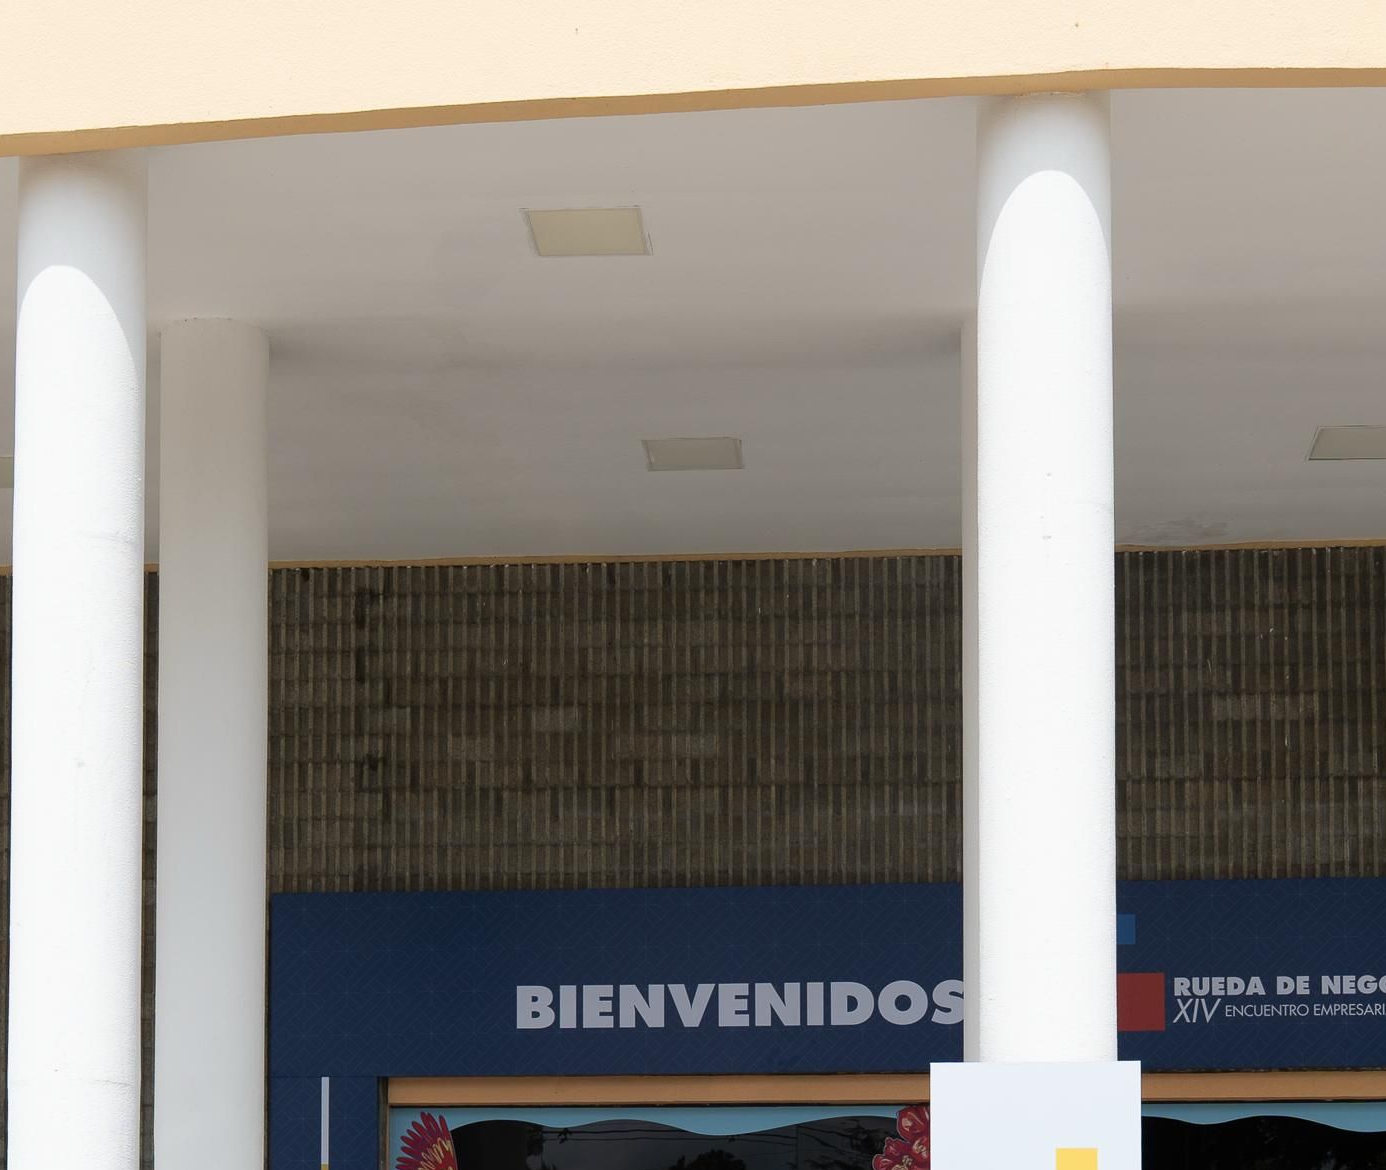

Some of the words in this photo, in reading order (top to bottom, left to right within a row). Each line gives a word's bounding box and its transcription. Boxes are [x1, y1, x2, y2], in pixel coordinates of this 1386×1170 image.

[1173, 976, 1266, 997] RUEDA
[1276, 975, 1311, 996] DE
[516, 979, 965, 1029] BIENVENIDOS
[1172, 998, 1222, 1024] XIV
[1225, 1004, 1310, 1018] ENCUENTRO
